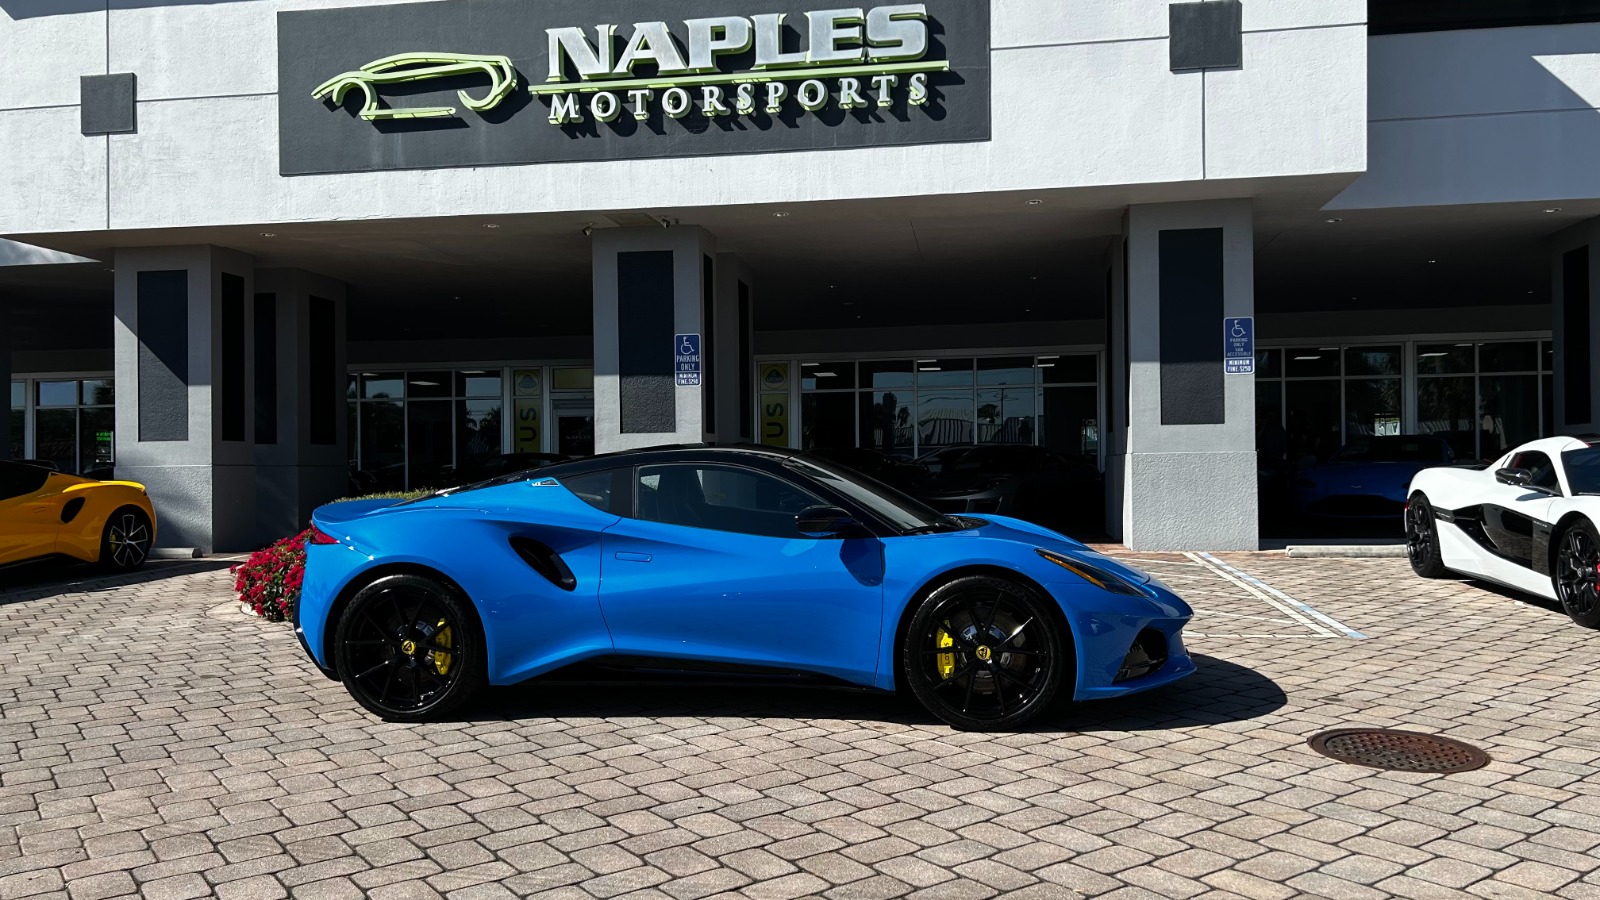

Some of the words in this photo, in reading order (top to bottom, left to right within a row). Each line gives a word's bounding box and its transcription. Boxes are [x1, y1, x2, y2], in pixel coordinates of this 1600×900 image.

[545, 4, 927, 82] NAPLES
[548, 73, 928, 125] MOTORSPORTS
[676, 354, 700, 363] PARKING
[680, 363, 695, 371] ONLY
